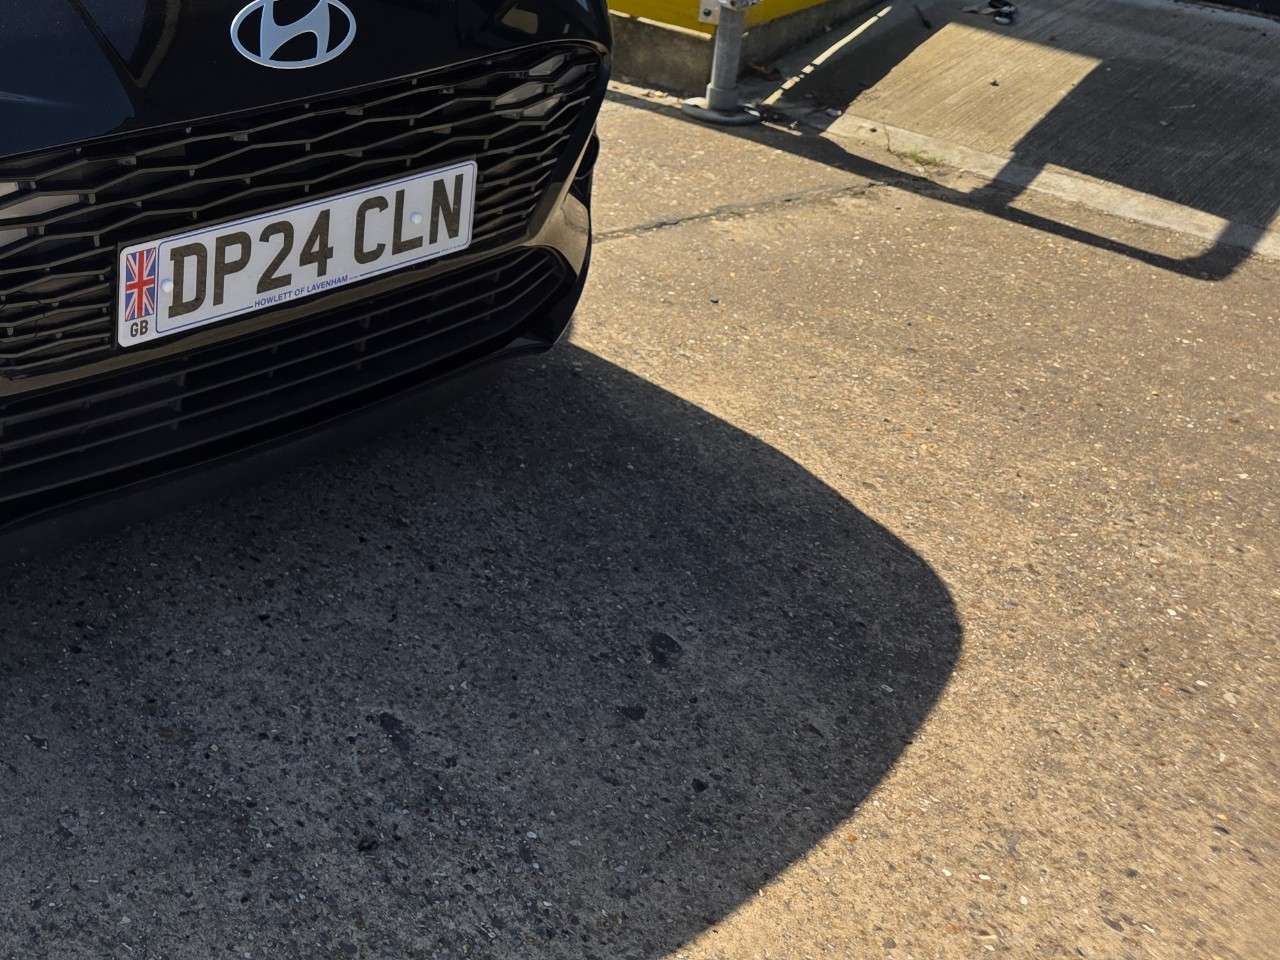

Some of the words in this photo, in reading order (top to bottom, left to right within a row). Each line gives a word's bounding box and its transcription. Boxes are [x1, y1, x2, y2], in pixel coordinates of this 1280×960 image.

[168, 208, 334, 318] DP24
[353, 173, 464, 265] CLN
[254, 291, 293, 308] HOWLETT
[294, 288, 306, 297] OF
[306, 274, 349, 293] LAVENHAM
[130, 319, 148, 338] GB
